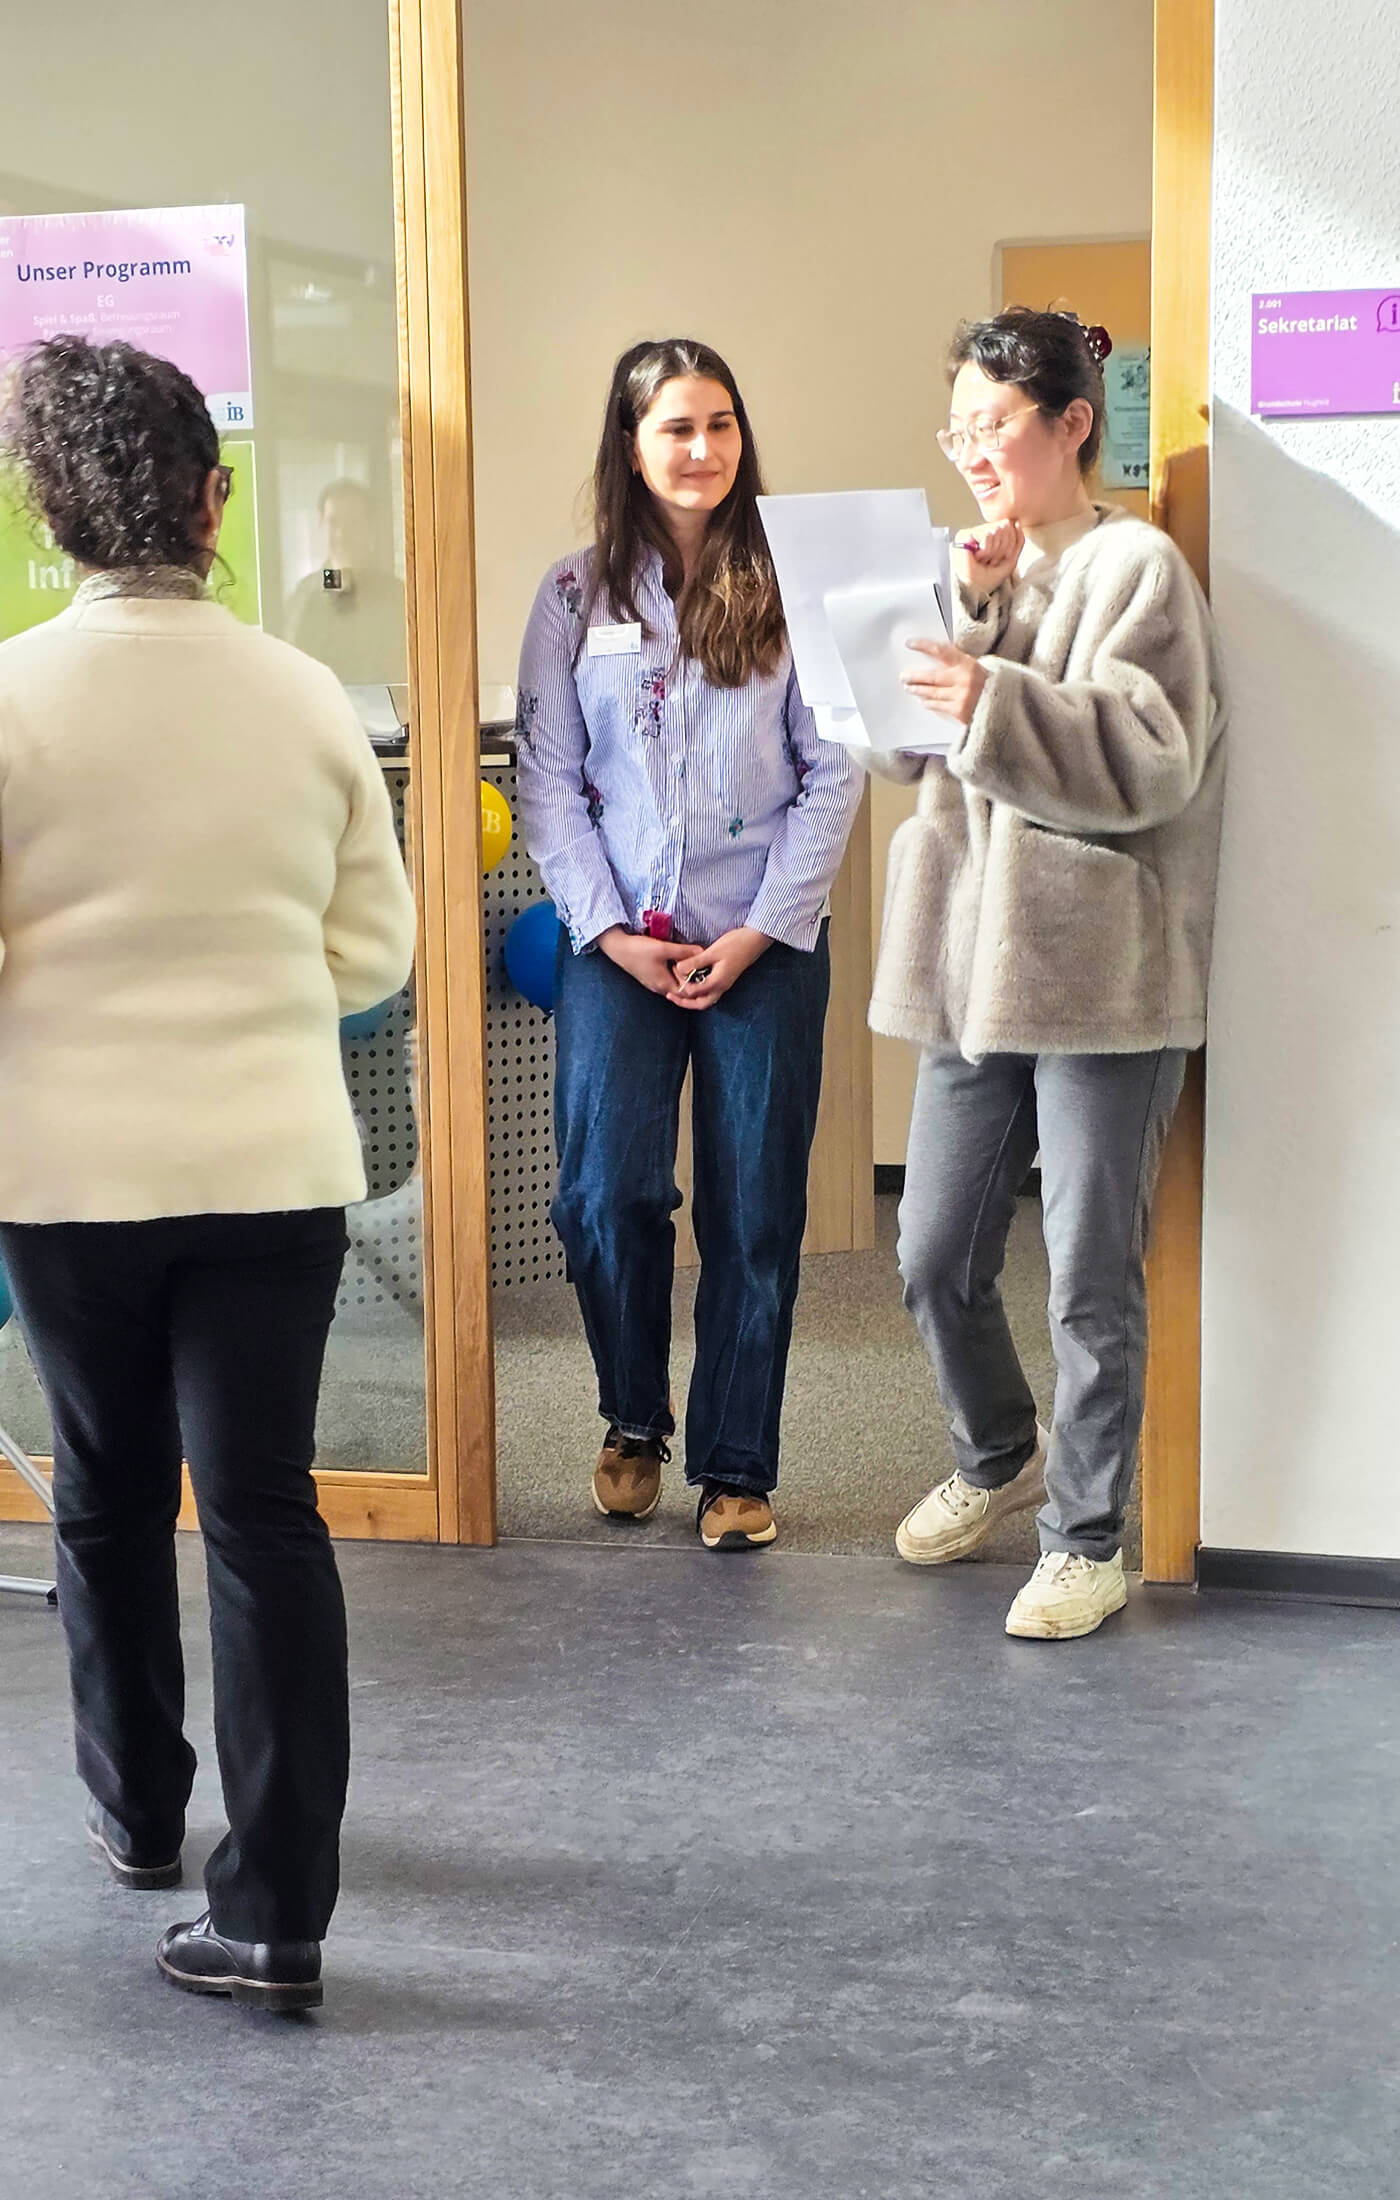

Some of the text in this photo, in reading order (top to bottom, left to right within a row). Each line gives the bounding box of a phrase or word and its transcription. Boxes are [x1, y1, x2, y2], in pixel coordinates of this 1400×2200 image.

[17, 259, 192, 283] Unser Programm
[97, 295, 115, 308] EG
[1258, 314, 1358, 334] Sekretariat
[28, 557, 75, 589] Inf
